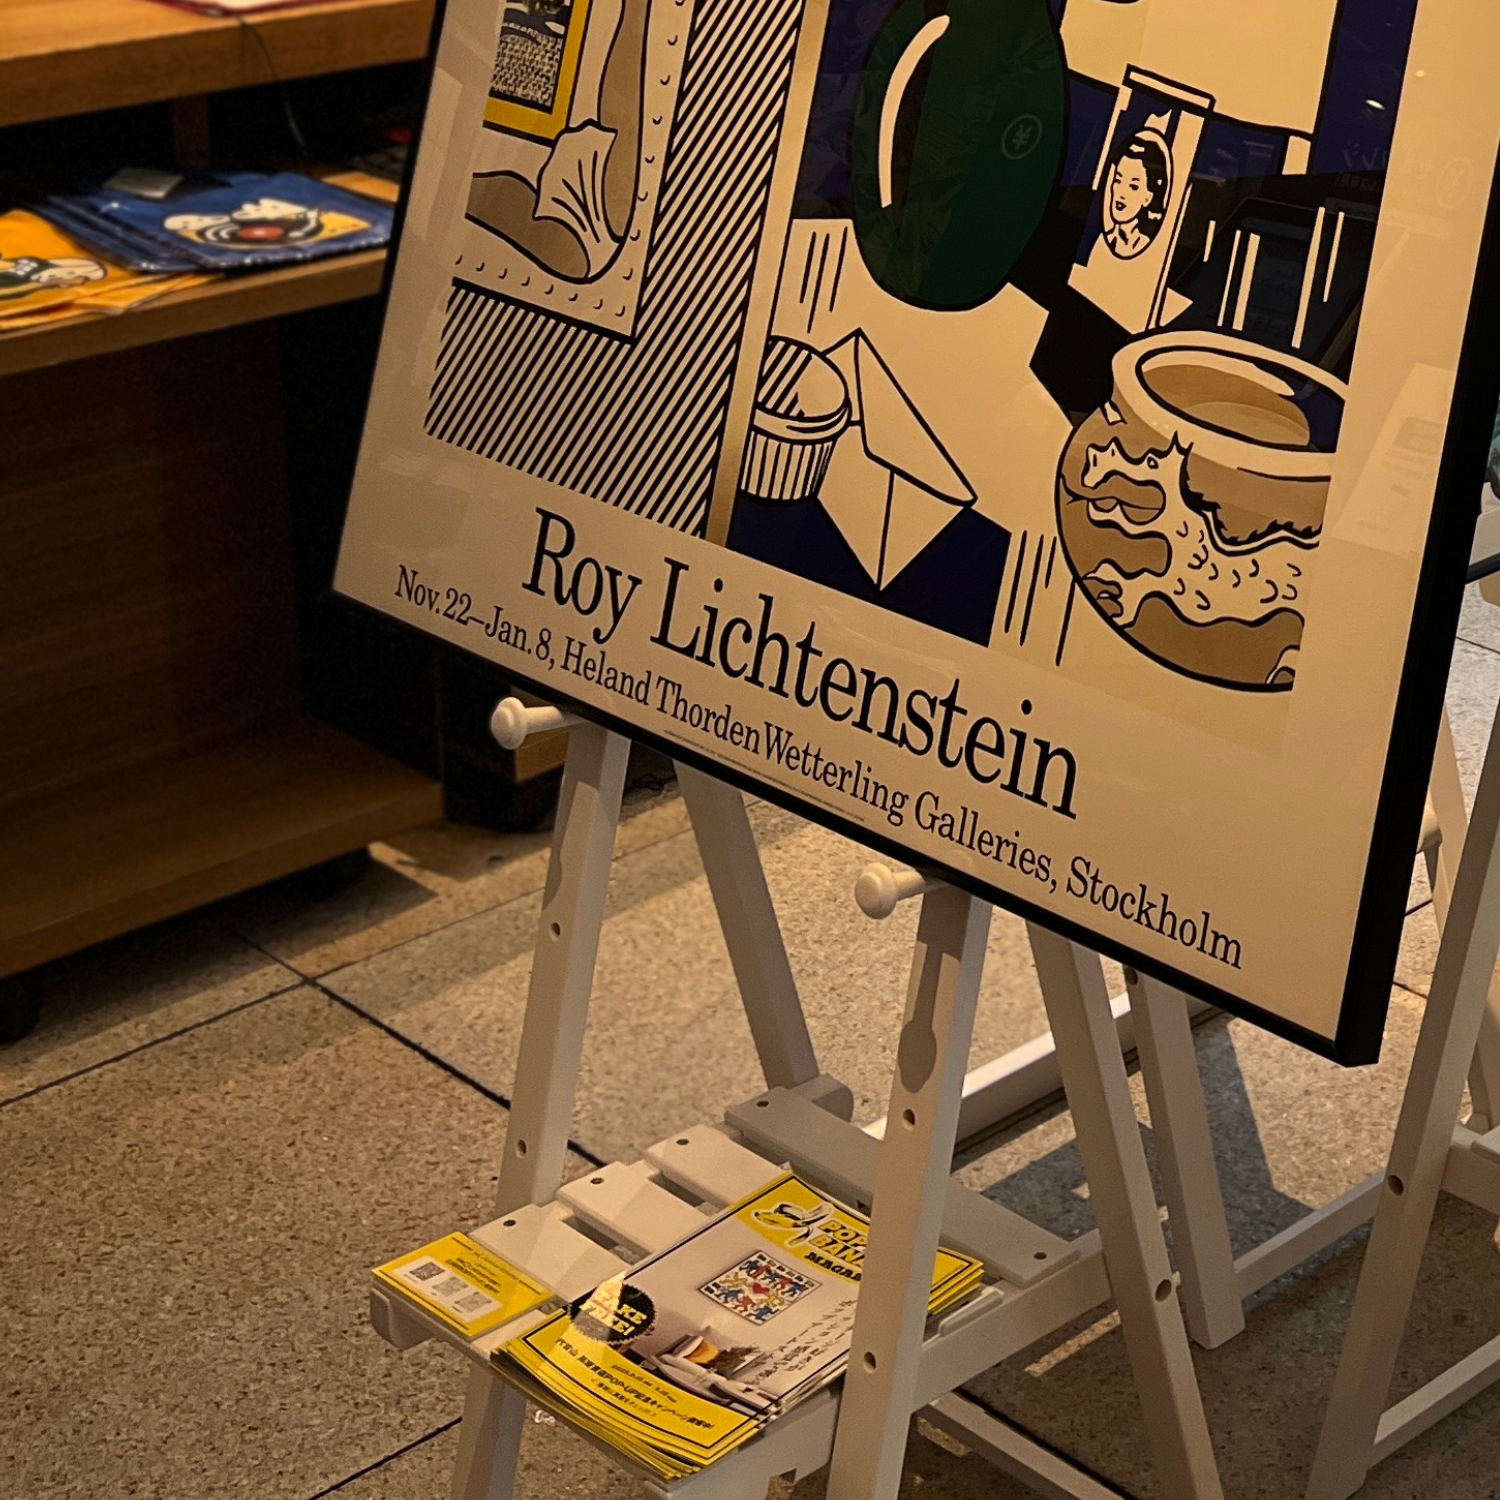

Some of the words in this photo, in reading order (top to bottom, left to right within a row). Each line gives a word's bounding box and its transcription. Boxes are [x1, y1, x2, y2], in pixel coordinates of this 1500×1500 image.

[521, 507, 643, 643] Roy
[649, 557, 1081, 820] Lichtenstein
[560, 635, 652, 706] Heland
[656, 675, 761, 755] Thorden
[764, 721, 909, 827] Wetterling
[915, 791, 1057, 894] Galleries,
[1066, 855, 1242, 970] Stockholm
